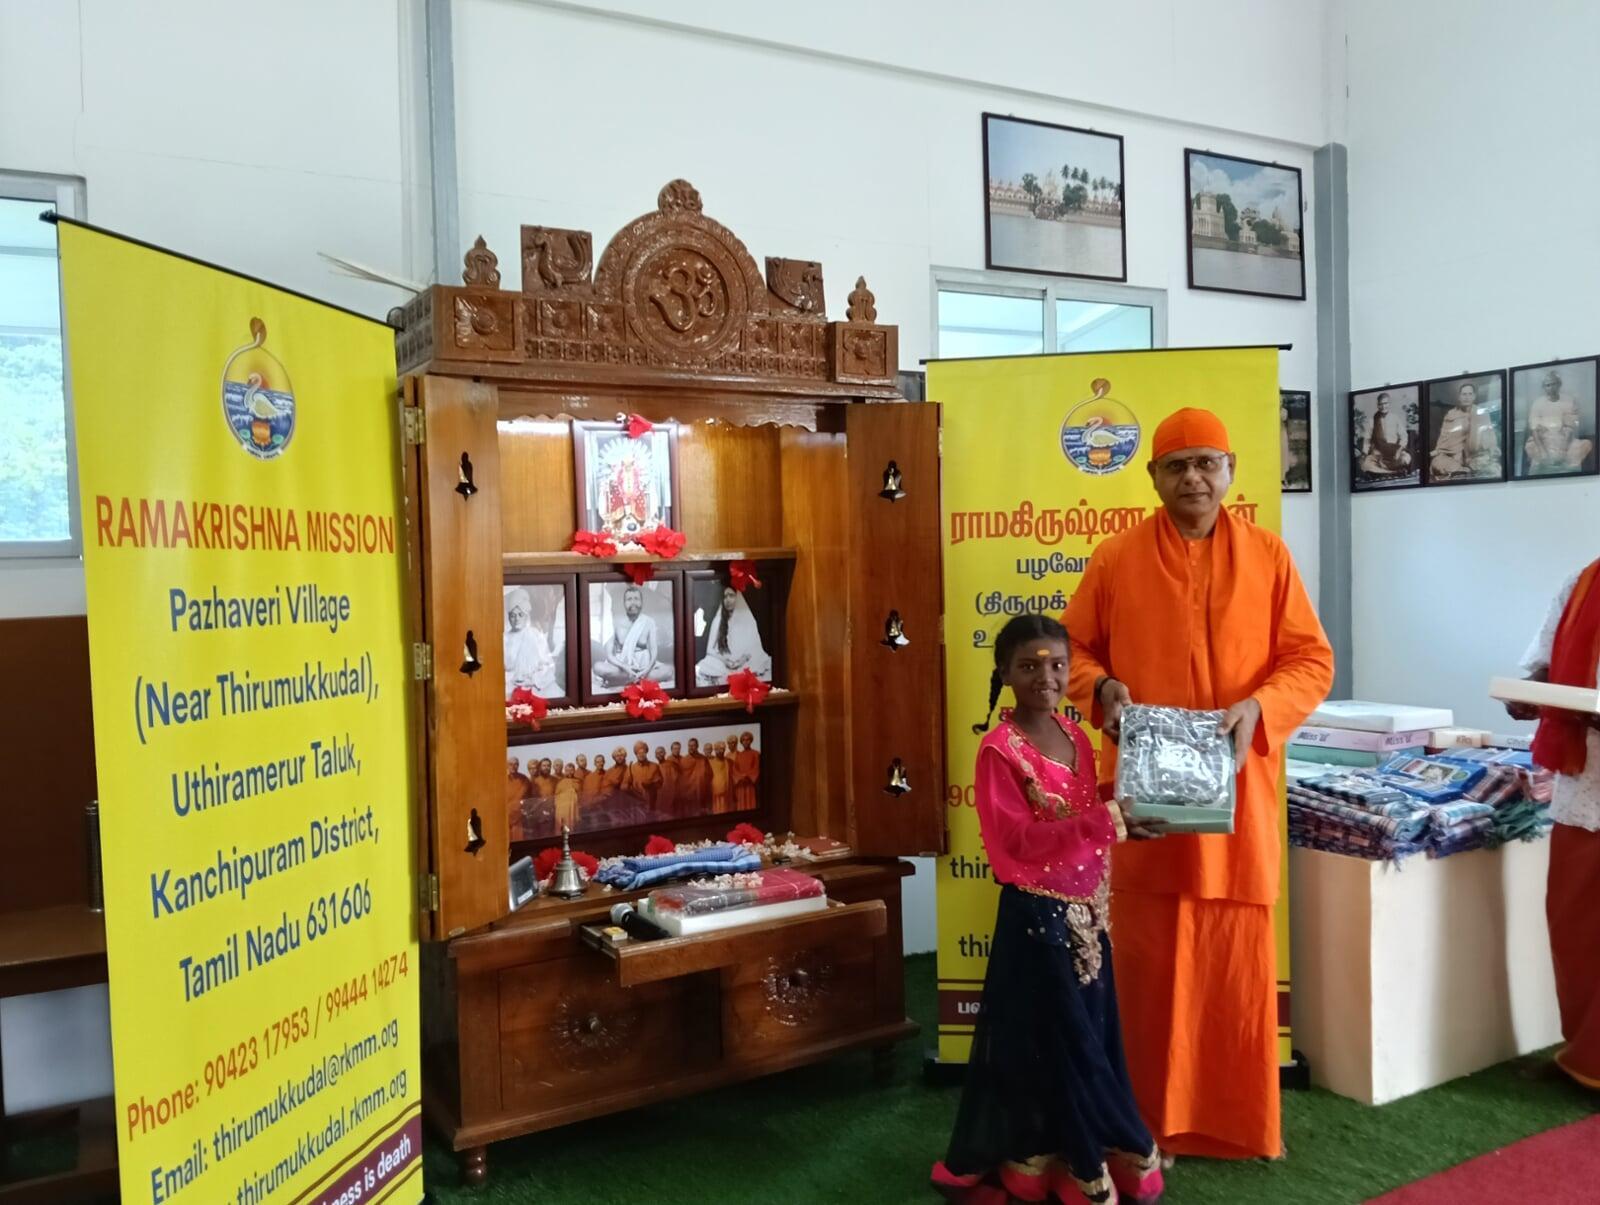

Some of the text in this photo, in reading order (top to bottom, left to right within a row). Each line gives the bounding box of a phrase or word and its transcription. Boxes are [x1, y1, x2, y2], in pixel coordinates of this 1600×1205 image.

[96, 495, 395, 554] RAMAKRISHNA MISSION
[169, 583, 350, 634] Pazhaveri Village
[134, 651, 379, 744] (Near Thirumukkudal),
[172, 732, 361, 817] Uthiramerur Taluk,
[150, 804, 379, 919] Kanchipuram District,
[179, 878, 371, 1003] Tamil Nadu 631606
[127, 951, 408, 1142] Phone: 90423 17953 / 99444 14274
[151, 1018, 399, 1205] Email: thirumukkudal@rkmm.org
[364, 1166, 376, 1192] is
[377, 1133, 411, 1179] death
